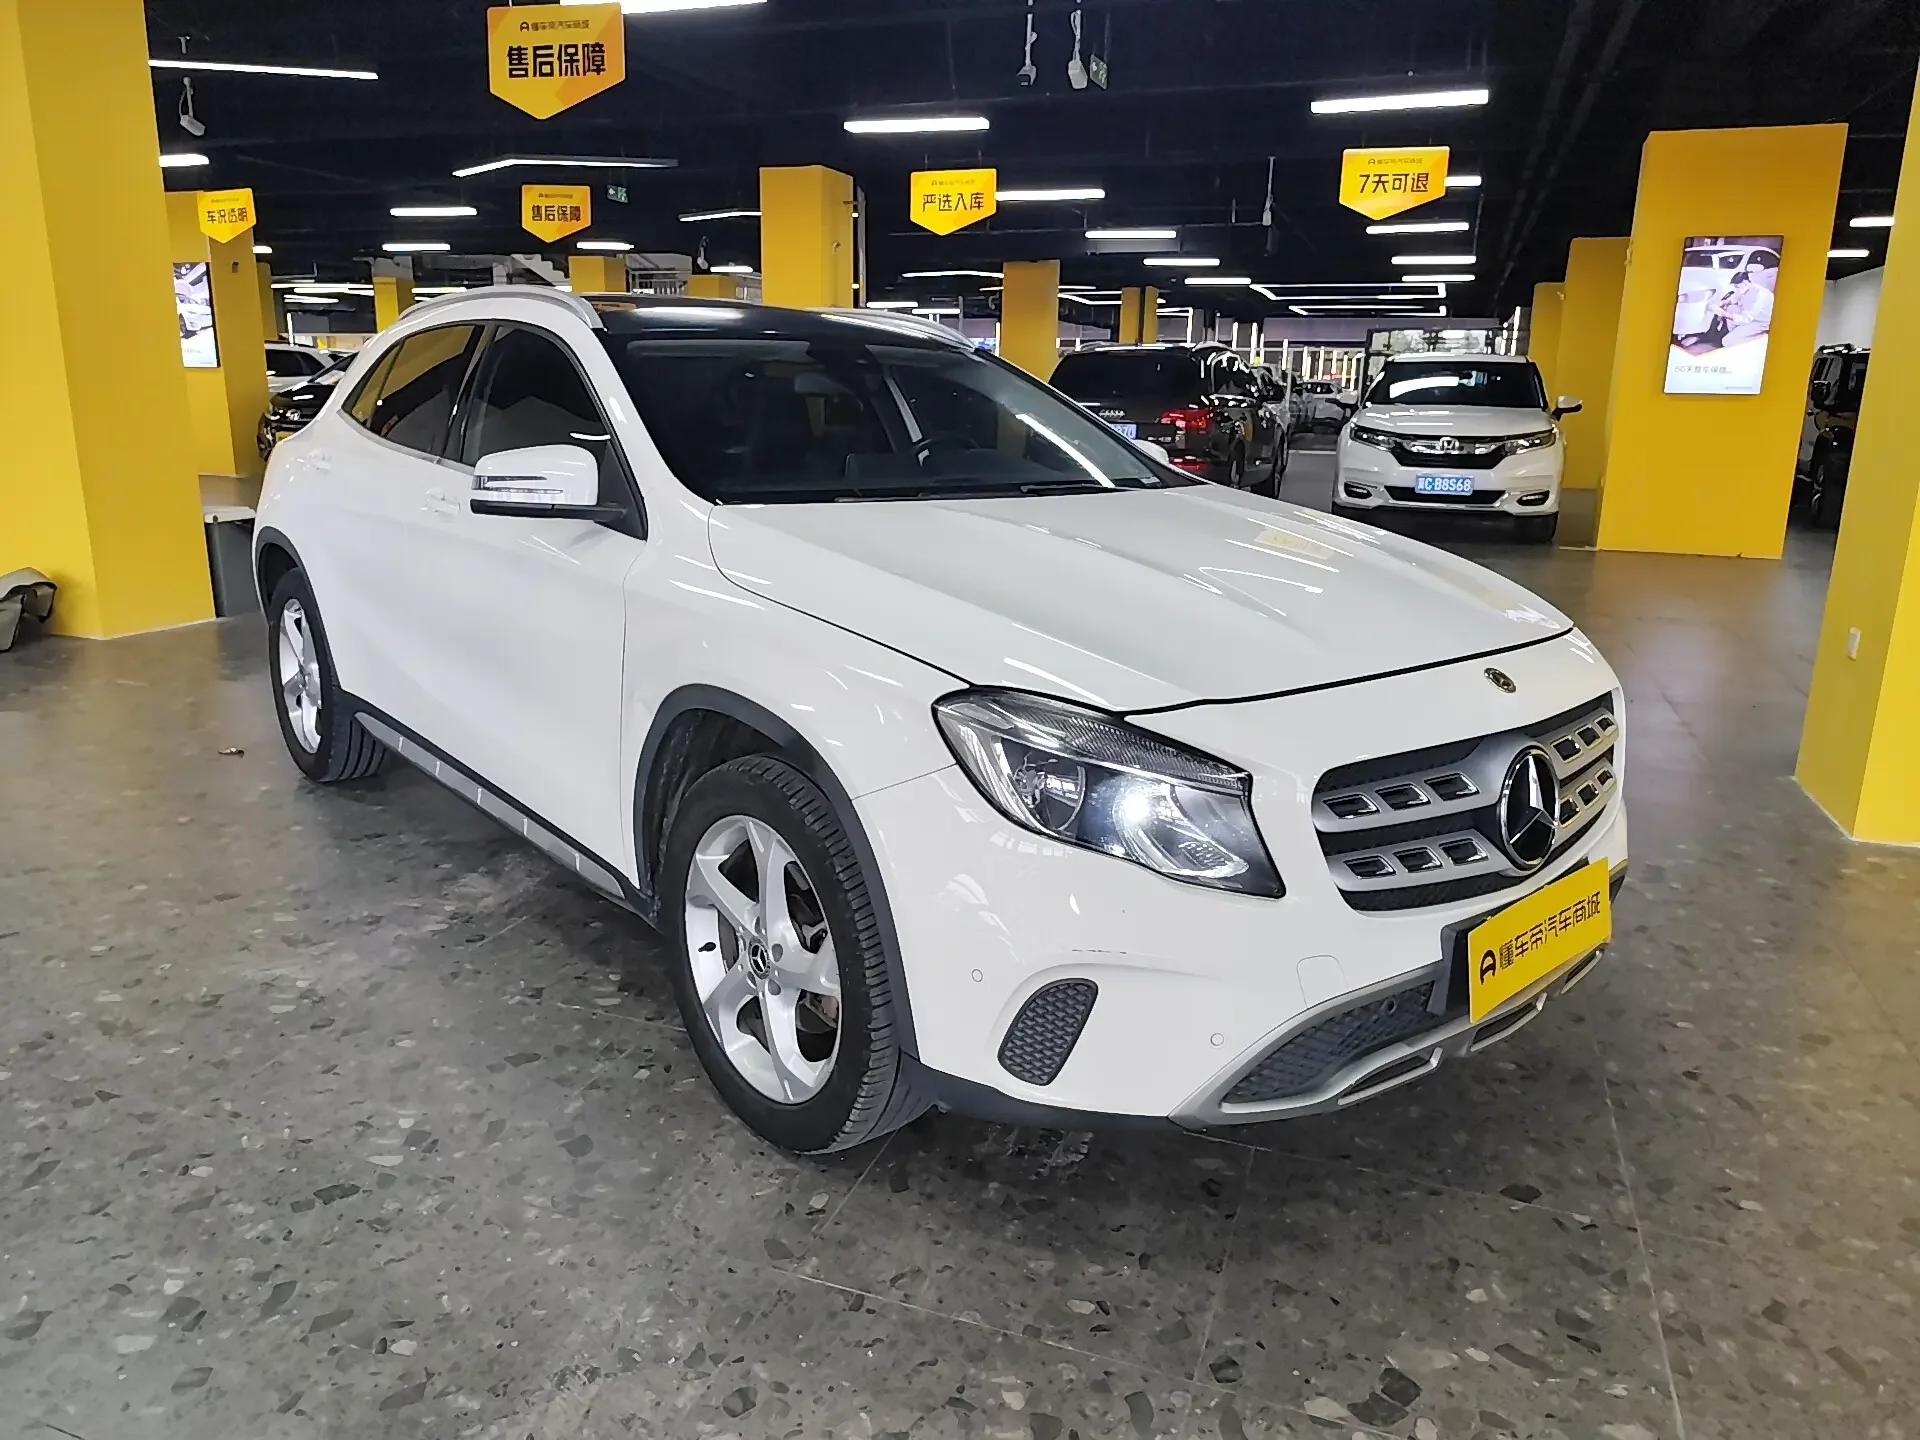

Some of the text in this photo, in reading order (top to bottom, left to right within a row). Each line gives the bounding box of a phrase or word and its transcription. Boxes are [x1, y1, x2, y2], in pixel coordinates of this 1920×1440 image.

[507, 42, 606, 78] 售后保障
[1359, 172, 1429, 193] 7天可退
[923, 192, 984, 212] 严选入库
[532, 205, 581, 222] 售后保障
[1499, 891, 1600, 970] 懂车帝汽车商城
